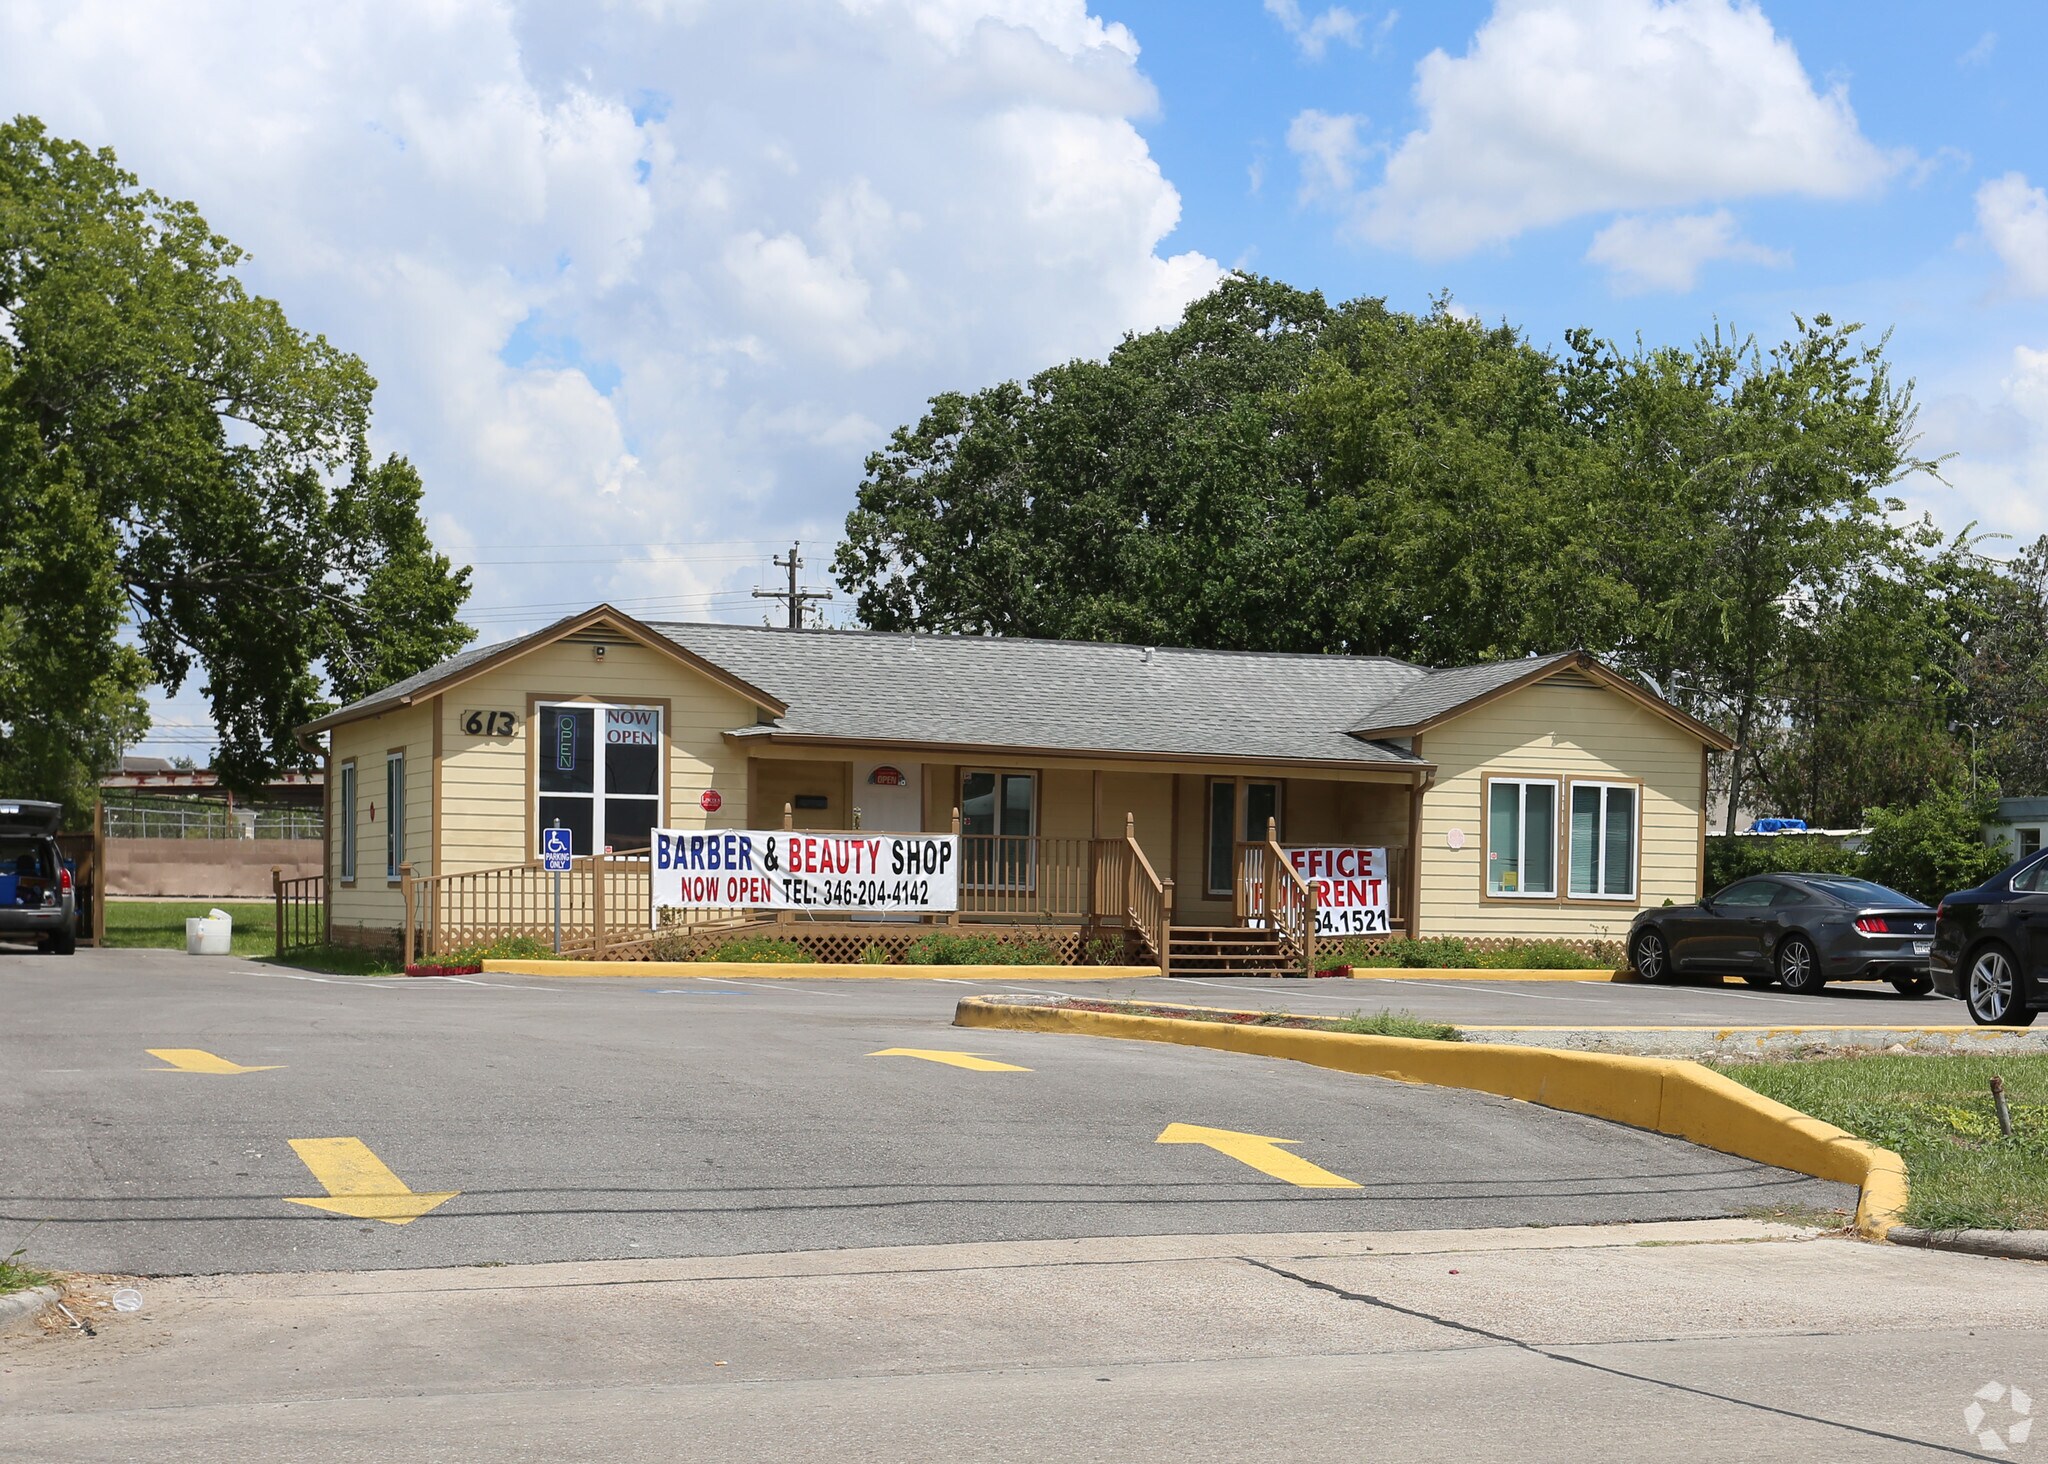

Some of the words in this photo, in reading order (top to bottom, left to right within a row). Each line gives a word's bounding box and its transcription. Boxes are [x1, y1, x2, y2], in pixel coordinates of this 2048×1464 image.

[466, 711, 516, 736] 613
[607, 710, 652, 725] NOW
[560, 717, 574, 768] OPEN
[607, 729, 653, 745] OPEN
[545, 852, 570, 861] PARKING
[550, 860, 566, 869] ONLY
[658, 834, 753, 871] BARBER
[764, 836, 779, 871] &
[789, 838, 881, 874] BEAUTY
[892, 840, 952, 875] SHOP
[1282, 850, 1373, 877] FFICE
[681, 876, 719, 902] NOW
[727, 876, 772, 903] OPEN
[783, 879, 817, 904] TEL:
[823, 880, 929, 905] 346-204-4142
[1317, 879, 1382, 907] RENT
